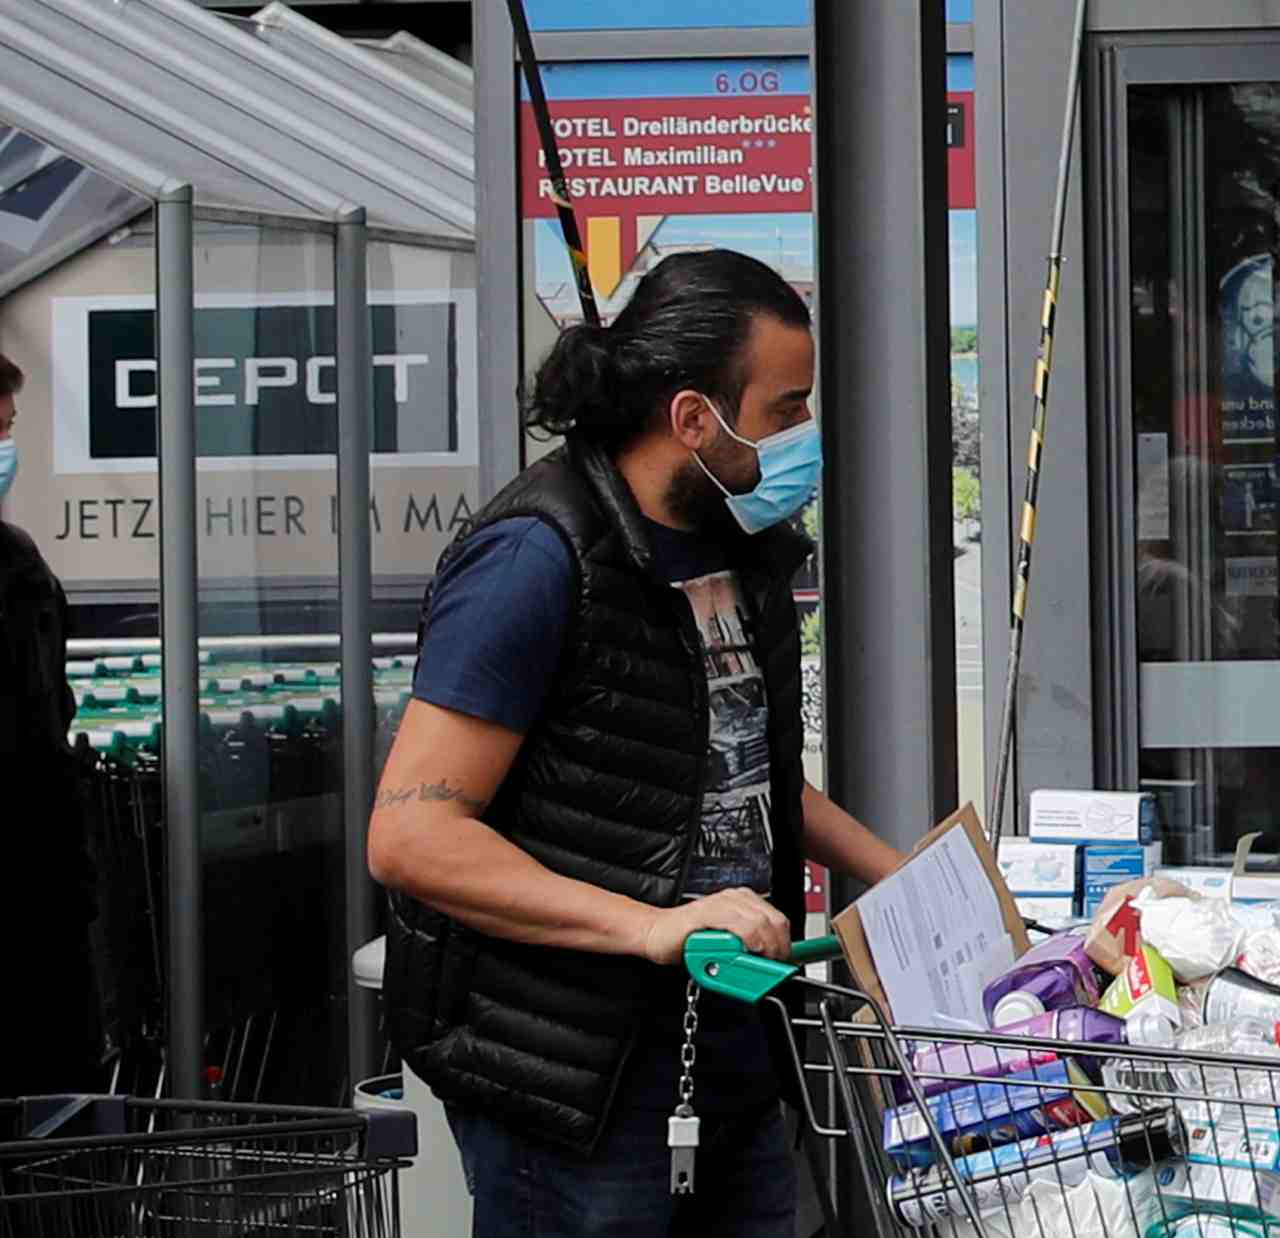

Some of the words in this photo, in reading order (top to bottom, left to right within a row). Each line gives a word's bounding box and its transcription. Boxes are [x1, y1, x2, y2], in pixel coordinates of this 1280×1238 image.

[715, 71, 780, 94] 6.OG
[550, 117, 617, 138] OTEL
[623, 145, 744, 167] Maximilian
[538, 175, 699, 198] RSTAURANT
[704, 173, 805, 194] BelleVue
[55, 499, 156, 540] JETZ
[205, 495, 307, 536] HIER
